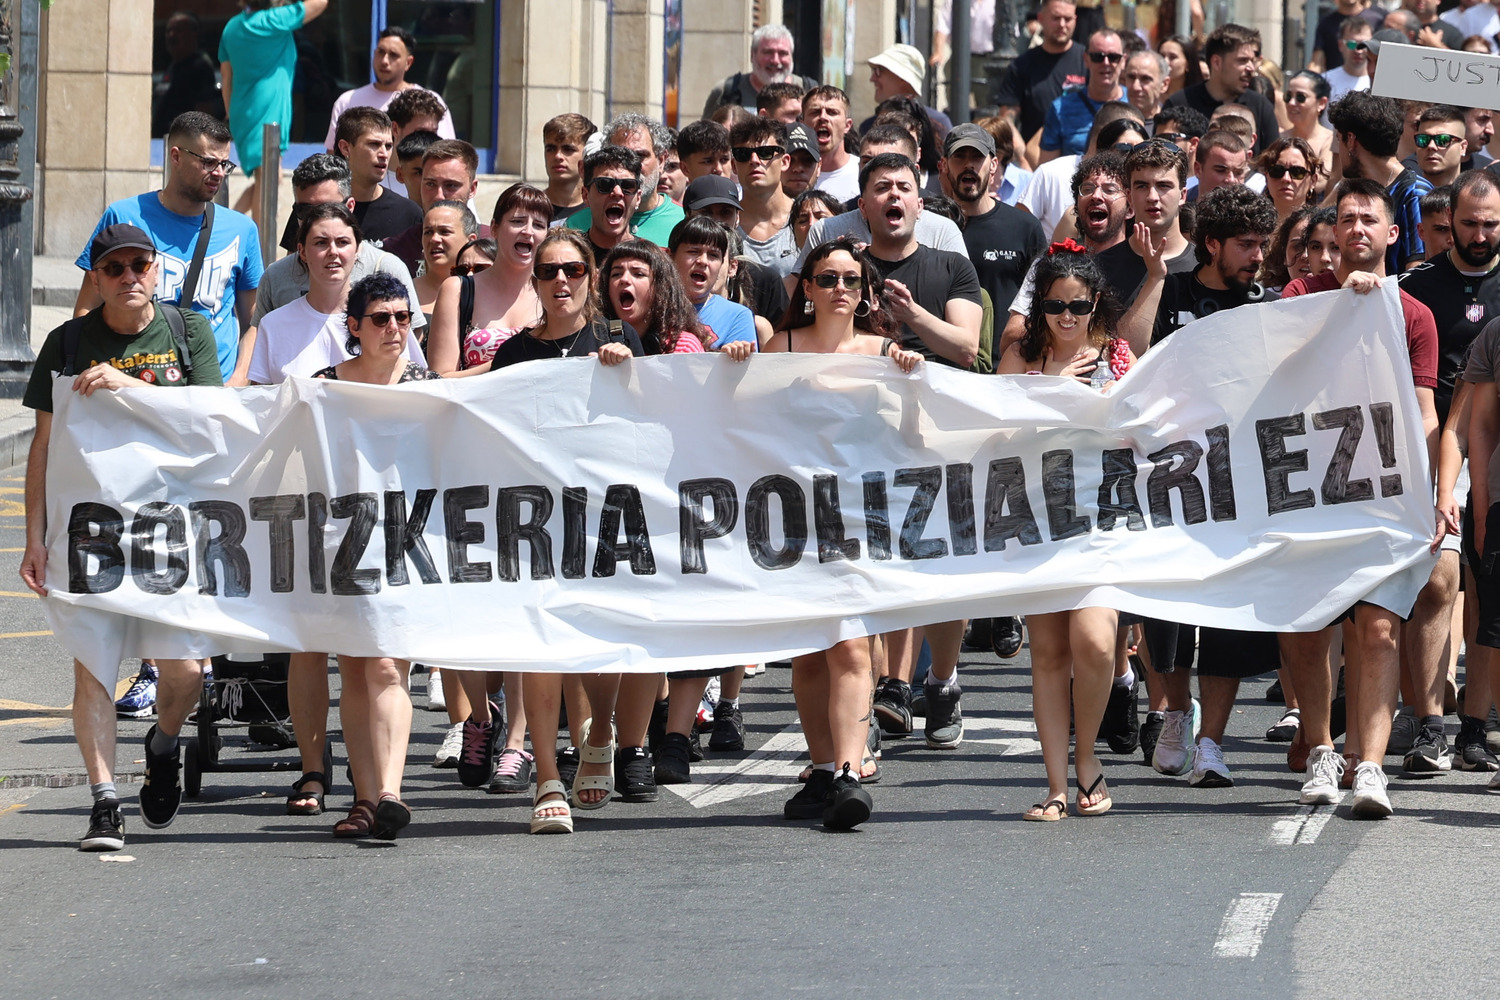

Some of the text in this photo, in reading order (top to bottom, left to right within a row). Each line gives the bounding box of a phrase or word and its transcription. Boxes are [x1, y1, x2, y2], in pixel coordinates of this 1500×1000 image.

[67, 401, 1405, 598] BORTIZKERIA POLIZIALARI EZ!
